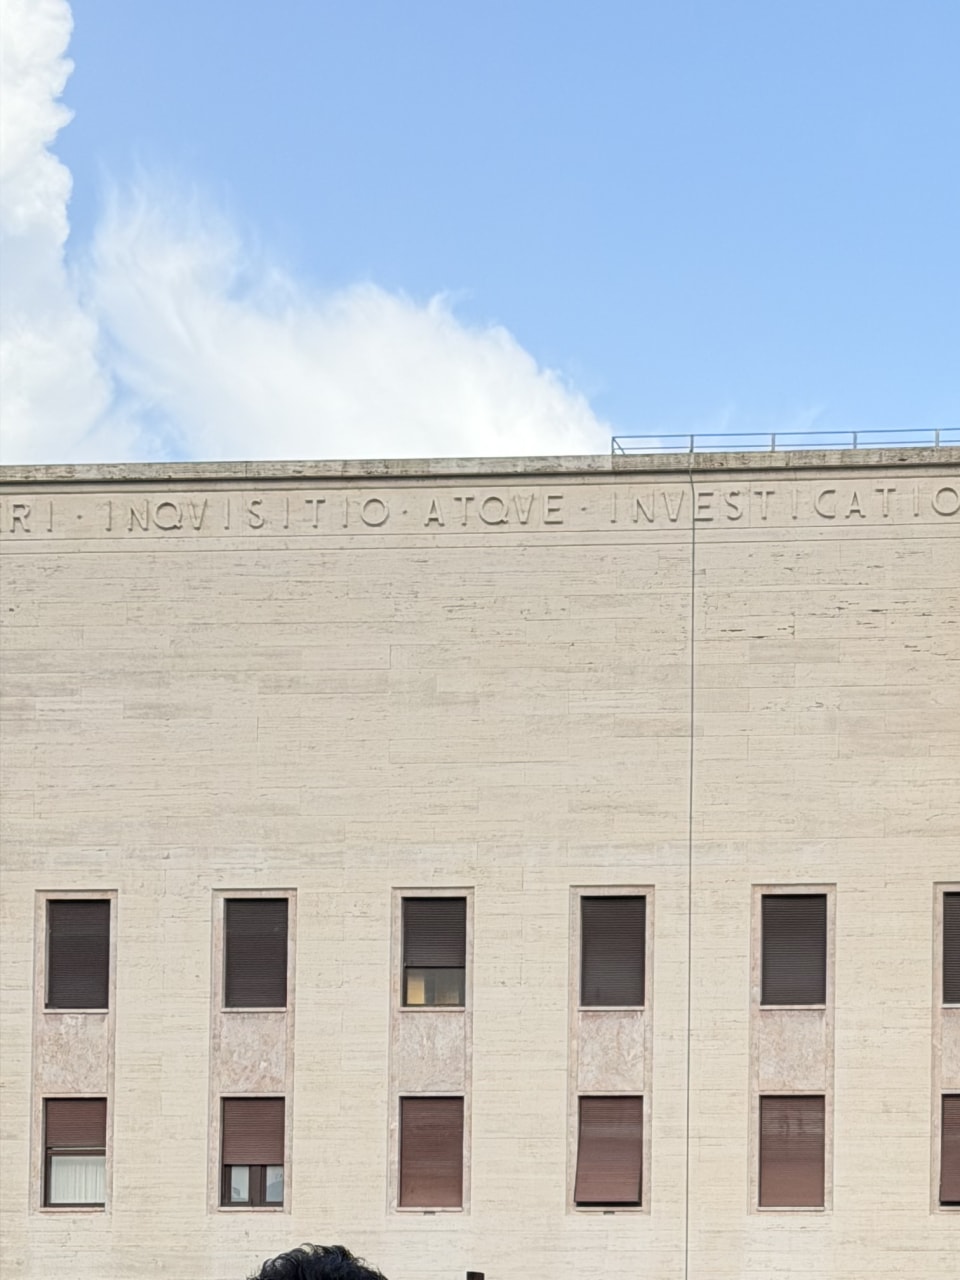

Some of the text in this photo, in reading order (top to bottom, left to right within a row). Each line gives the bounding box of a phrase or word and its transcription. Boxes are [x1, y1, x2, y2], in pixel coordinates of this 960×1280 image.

[0, 500, 54, 533] RI
[105, 496, 390, 532] INQVISITIO
[423, 494, 564, 527] ATQVE
